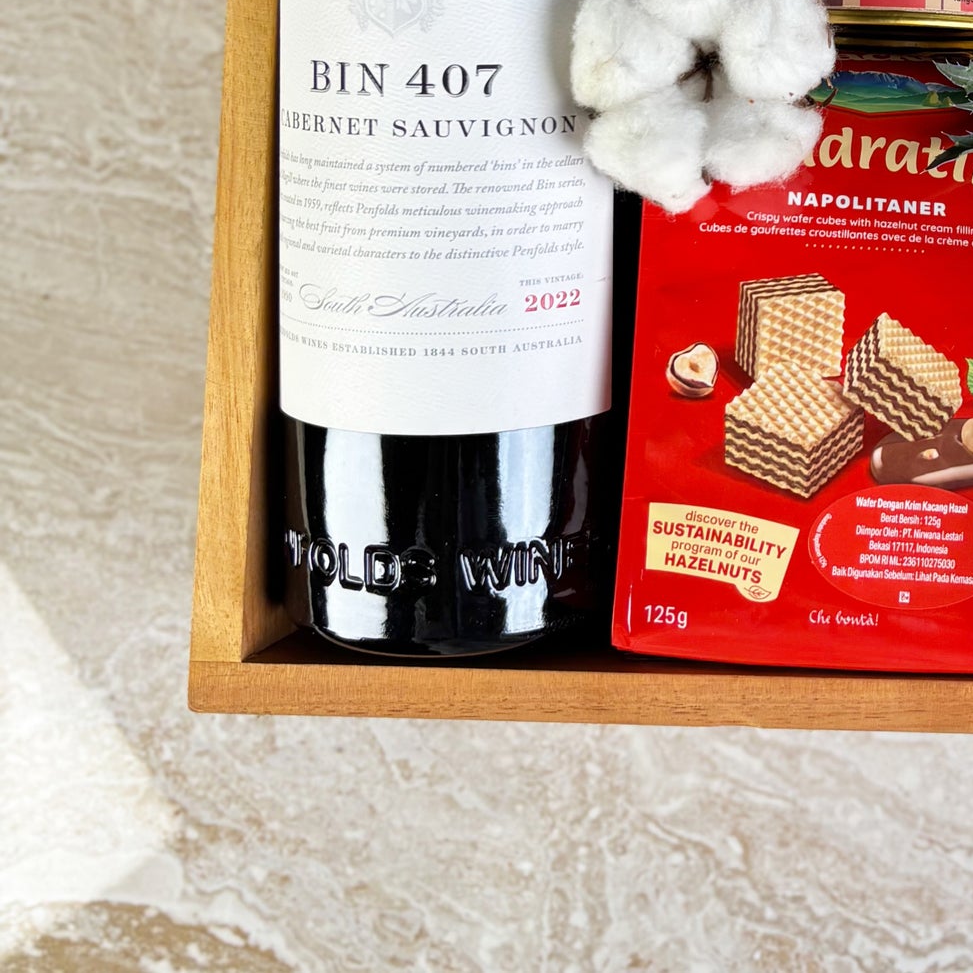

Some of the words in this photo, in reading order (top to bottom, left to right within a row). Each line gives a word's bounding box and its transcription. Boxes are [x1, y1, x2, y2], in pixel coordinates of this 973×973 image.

[310, 59, 390, 97] BIN
[405, 63, 503, 97] 407
[281, 108, 378, 137] CABERNET
[392, 114, 577, 138] SAUVIGNON
[314, 157, 364, 171] maintained
[375, 163, 410, 175] system
[428, 160, 488, 173] numbered
[536, 158, 553, 169] the
[554, 155, 584, 168] cellars
[322, 179, 347, 192] finest
[349, 182, 378, 193] wines
[381, 186, 409, 194] were
[410, 182, 449, 194] stored.
[452, 182, 473, 194] The
[475, 180, 534, 193] renowned
[536, 178, 556, 191] Bin
[324, 201, 354, 215] reflects
[356, 202, 400, 218] Penfolds
[402, 204, 462, 217] meticulous
[465, 202, 537, 217] winemaking
[539, 196, 584, 215] approach
[787, 190, 947, 217] NAPOLITANER
[320, 221, 342, 235] fruit
[341, 223, 366, 238] from
[368, 227, 421, 240] premium
[424, 226, 488, 242] vineyards,
[506, 223, 538, 235] order
[552, 220, 584, 232] marry
[747, 211, 780, 224] Crispy
[783, 214, 812, 224] wafer
[816, 215, 847, 227] cubes
[850, 218, 871, 228] with
[873, 219, 918, 231] hazelnut
[921, 224, 953, 234] cream
[699, 222, 731, 233] Cubes
[734, 223, 748, 233] de
[750, 225, 807, 236] gaufrettes
[808, 228, 879, 241] croustillantes
[881, 234, 906, 242] avec
[908, 233, 922, 243] de
[936, 236, 969, 247] crème
[317, 244, 352, 256] varietal
[353, 247, 407, 260] characters
[423, 248, 442, 260] the
[445, 247, 509, 260] distinctive
[512, 243, 559, 259] Penfolds
[560, 239, 585, 255] style.
[519, 279, 542, 287] THIS
[299, 283, 371, 315] South
[367, 292, 509, 318] Australia
[524, 288, 581, 312] 2022
[332, 342, 416, 357] ESTABLISHED
[423, 347, 455, 357] 1844
[461, 345, 506, 357] SOUTH
[512, 335, 583, 353] AUSTRALIA
[856, 496, 877, 508] Wafer
[877, 498, 904, 512] Dengan
[904, 500, 921, 510] Krim
[922, 501, 947, 515] Kacang
[949, 503, 968, 514] Hazel
[685, 510, 737, 529] discover
[739, 521, 759, 534] the
[880, 513, 898, 523] Berat
[924, 516, 941, 528] 125g
[652, 520, 787, 559] SUSTAINABILITY
[855, 526, 883, 540] Diimpor
[913, 529, 941, 541] Nirwana
[941, 531, 964, 542] Lestari
[671, 540, 722, 556] program
[725, 548, 738, 560] of
[740, 555, 762, 567] our
[859, 553, 880, 565] BPOM
[868, 541, 891, 552] Bekasi
[916, 543, 949, 555] Indonesia
[664, 552, 763, 584] HAZELNUTS
[847, 567, 883, 581] Digunakan
[644, 605, 688, 629] 125g
[809, 609, 831, 624] Che
